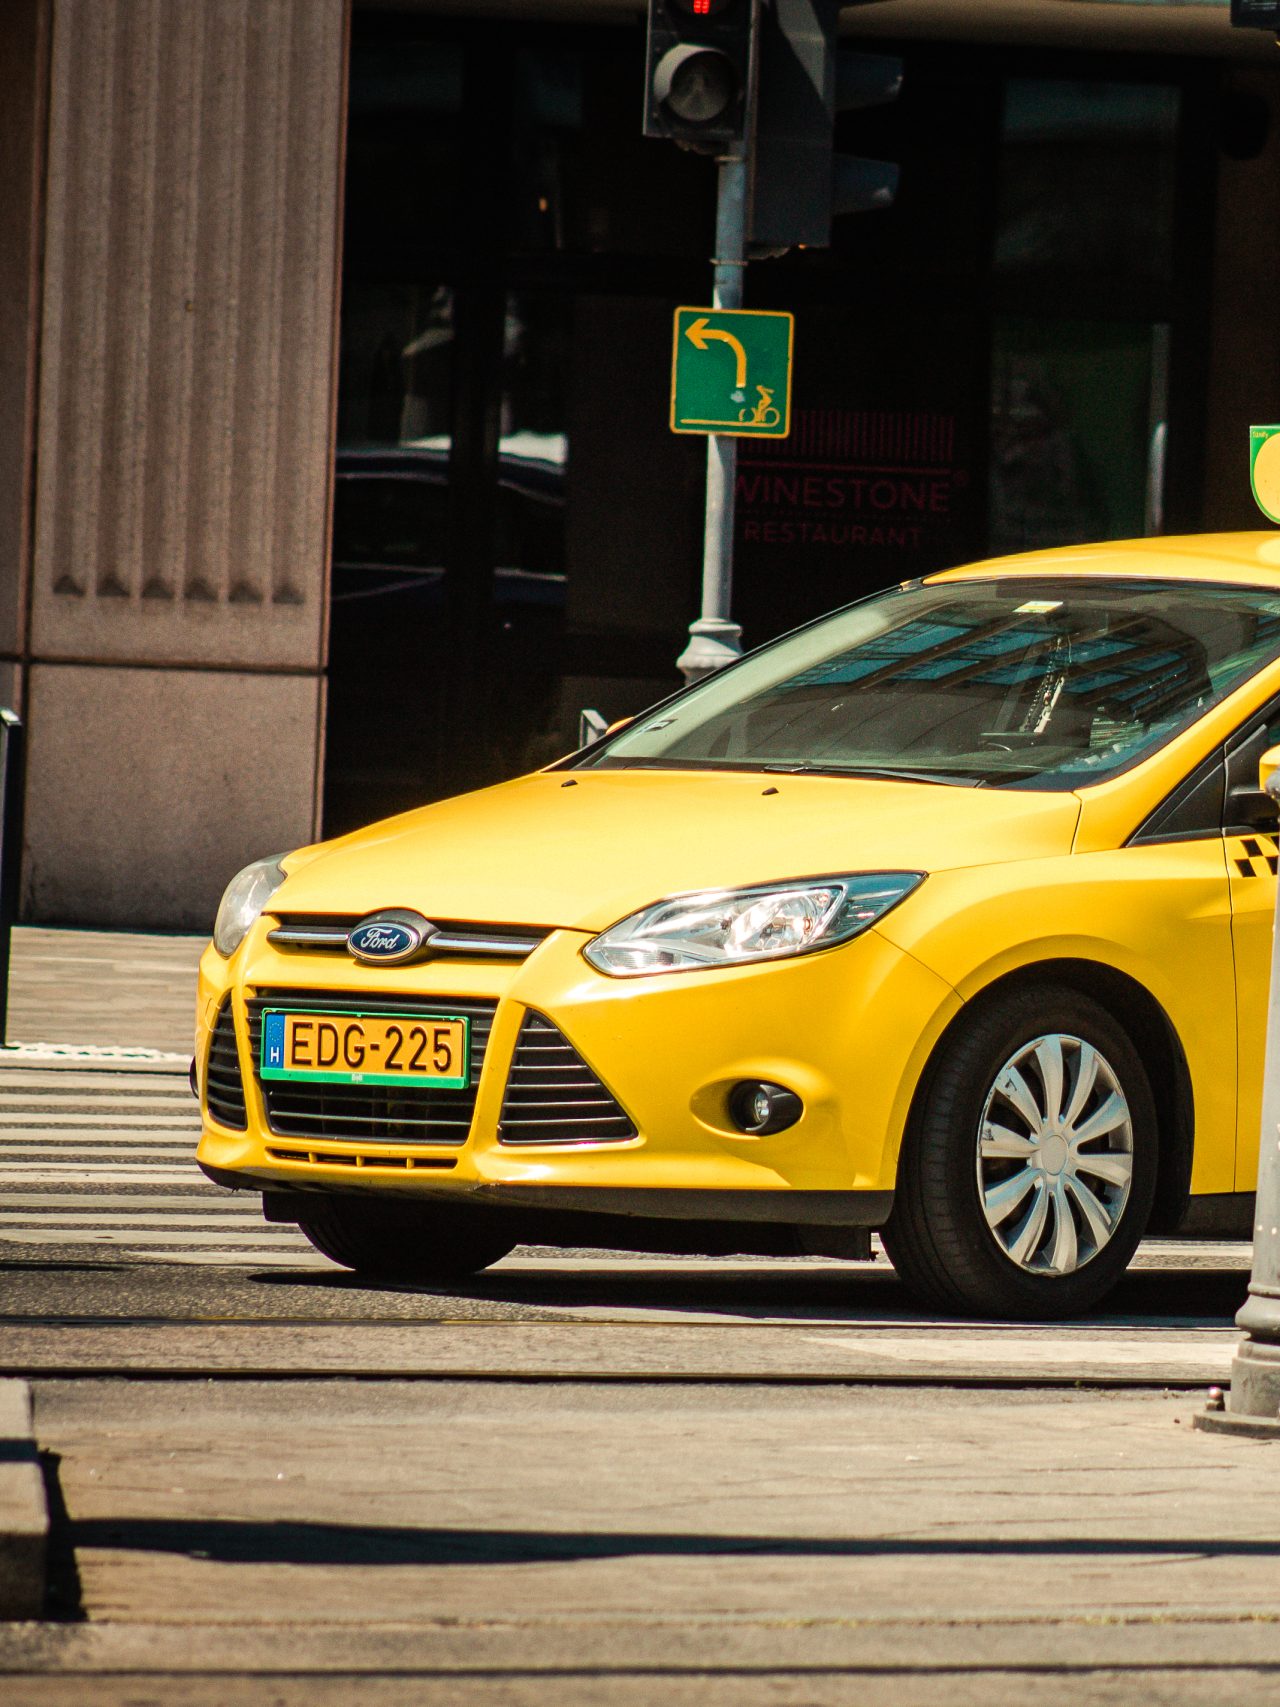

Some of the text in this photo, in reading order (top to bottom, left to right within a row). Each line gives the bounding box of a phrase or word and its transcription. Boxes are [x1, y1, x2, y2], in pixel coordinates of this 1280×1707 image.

[743, 520, 924, 546] RESTAURANT
[360, 927, 401, 950] Ford
[270, 1046, 280, 1063] H
[291, 1020, 453, 1073] EDG-225
